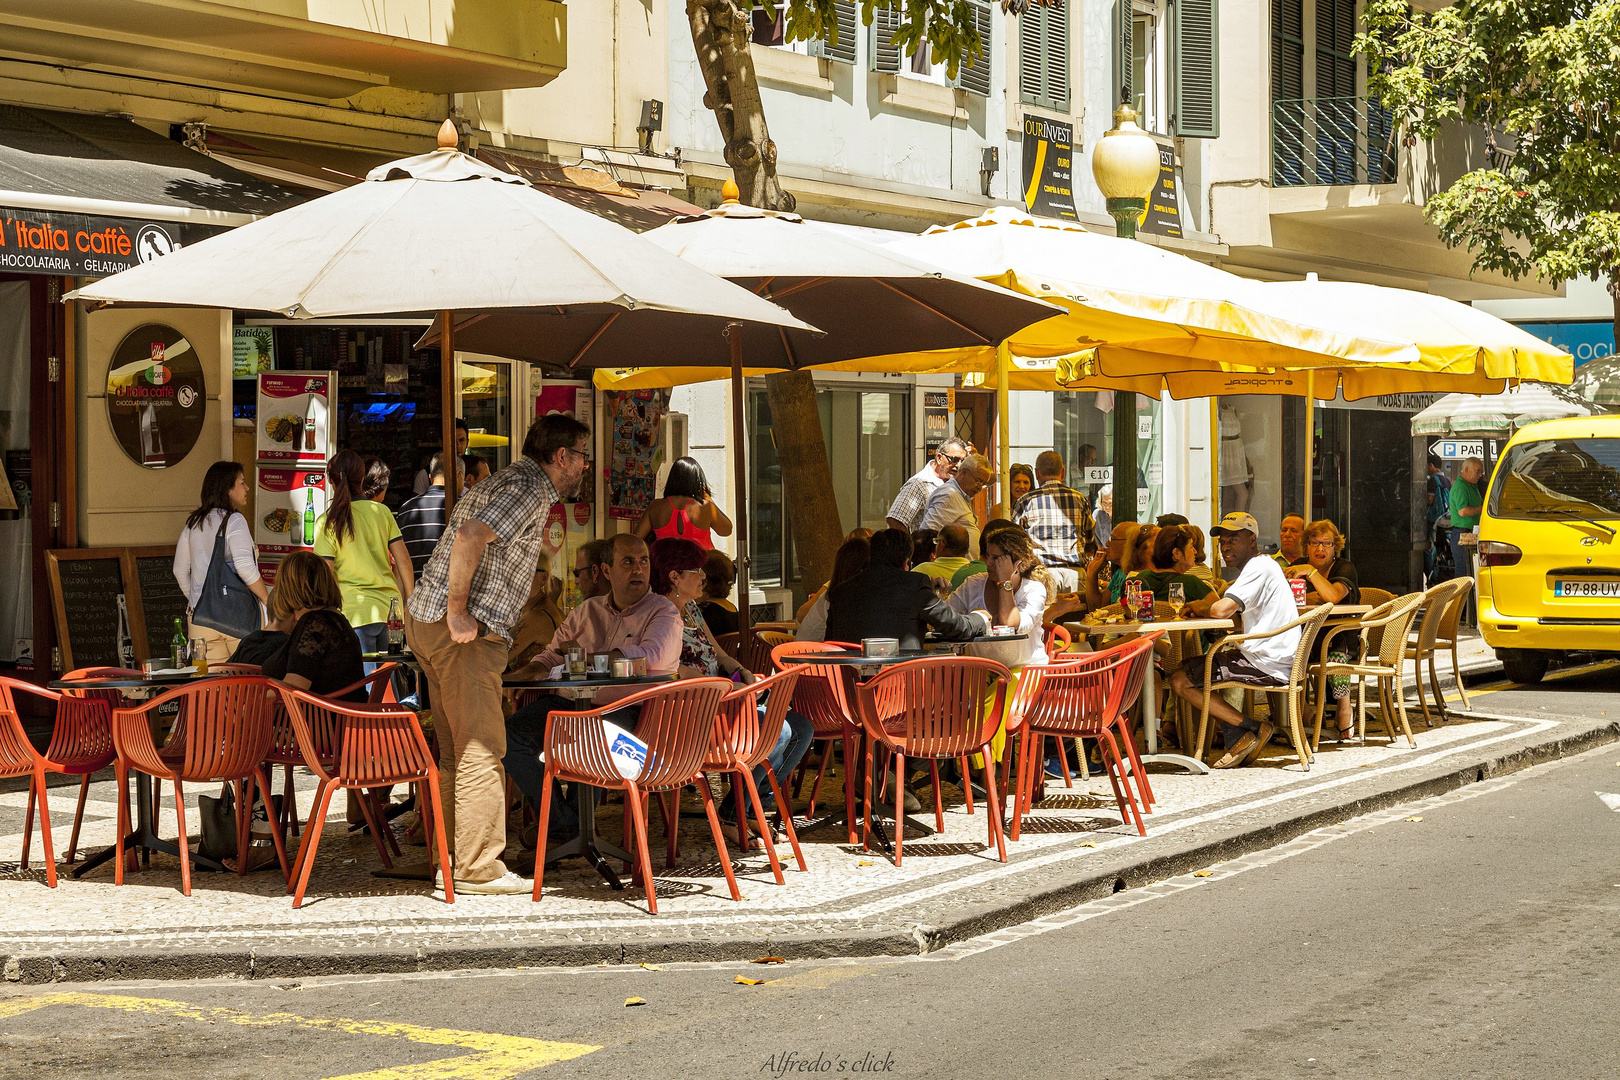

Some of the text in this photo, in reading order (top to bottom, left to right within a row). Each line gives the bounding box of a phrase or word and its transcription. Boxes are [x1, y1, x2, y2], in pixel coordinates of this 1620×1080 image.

[1025, 120, 1071, 143] OURINVEST
[1057, 157, 1070, 169] OURO
[75, 226, 132, 256] caffè
[0, 253, 71, 270] HOCOLATARIA
[234, 328, 269, 337] Batidos
[150, 385, 174, 397] caffè
[1377, 394, 1434, 409] MODAS JACINTO'S
[928, 414, 946, 430] OURO
[1090, 469, 1110, 480] €10
